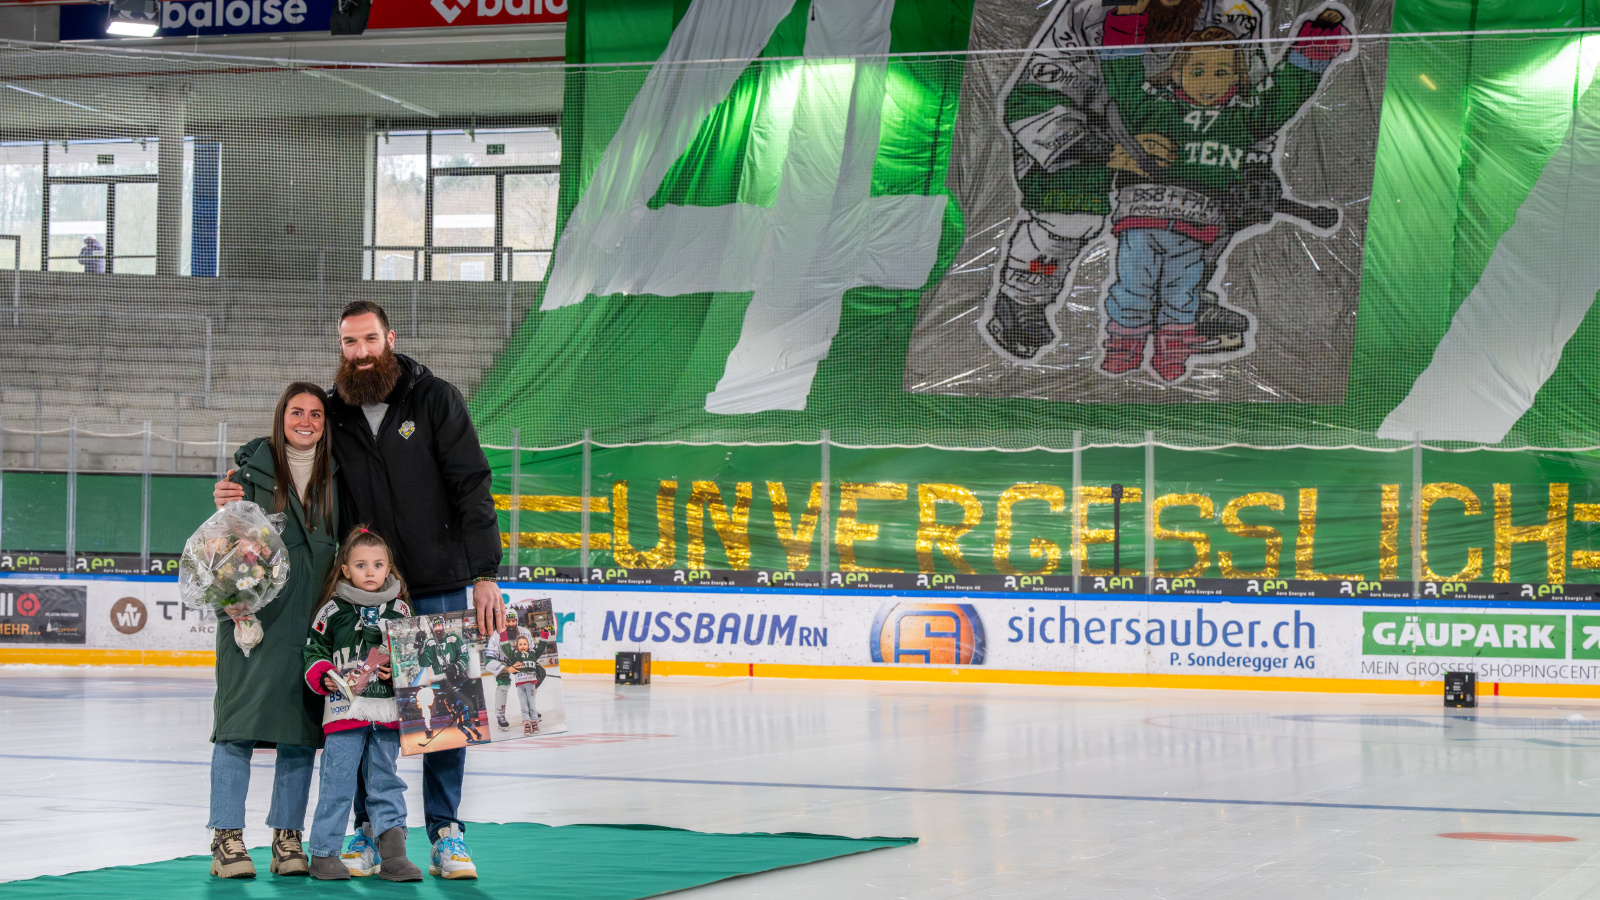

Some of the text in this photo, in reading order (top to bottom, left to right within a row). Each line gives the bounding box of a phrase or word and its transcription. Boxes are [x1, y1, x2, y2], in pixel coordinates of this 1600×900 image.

[162, 0, 307, 29] baloise
[1183, 110, 1220, 133] 47
[1184, 141, 1244, 170] TEN
[151, 559, 181, 574] a.e
[0, 624, 41, 635] EHR...
[601, 611, 798, 645] NUSSBAUM
[799, 627, 828, 647] RN
[1008, 606, 1315, 649] sichersauber.ch
[1372, 616, 1556, 649] GÄUPARK
[1170, 653, 1315, 672] P. Sonderegger AG
[1361, 661, 1399, 675] MEIN
[1481, 663, 1600, 680] SHOPPINGCENT
